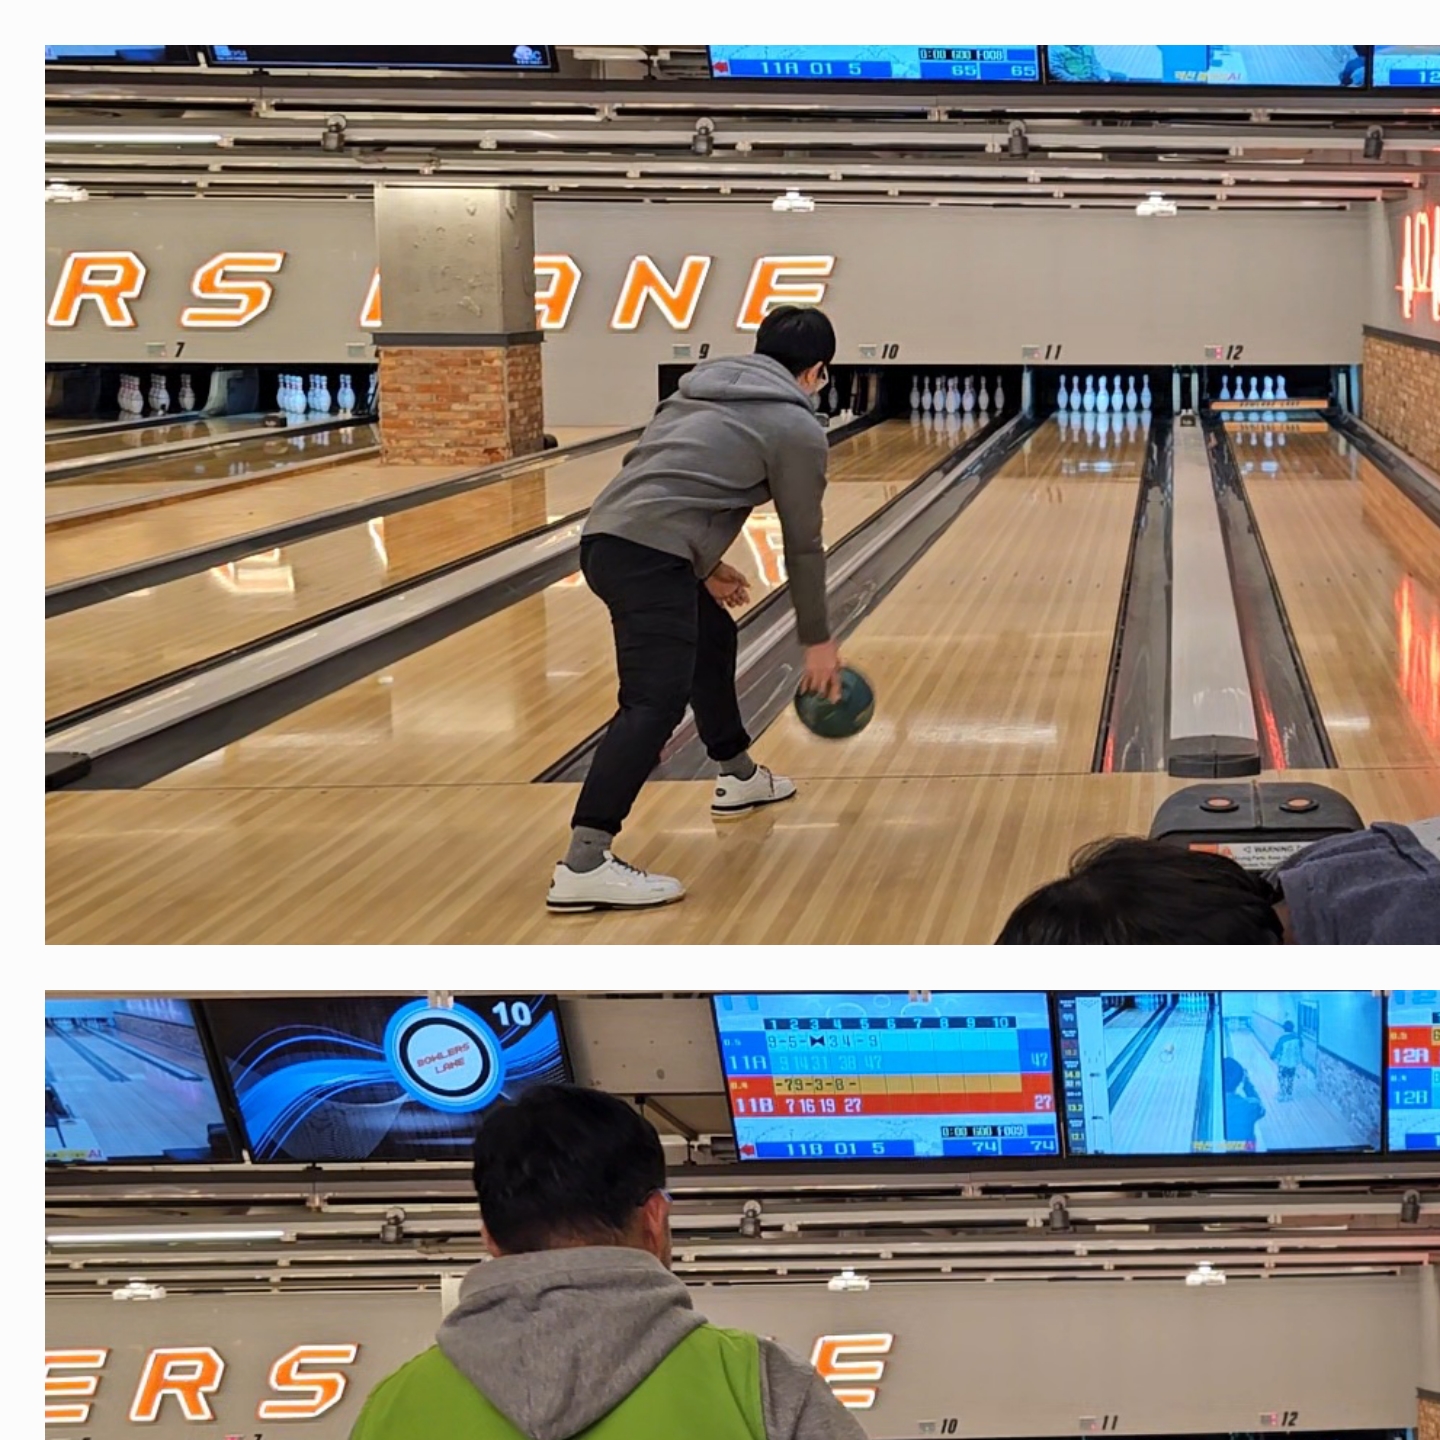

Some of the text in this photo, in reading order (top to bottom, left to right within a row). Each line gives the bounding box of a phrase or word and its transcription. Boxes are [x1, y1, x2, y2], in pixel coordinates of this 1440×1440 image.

[761, 62, 861, 74] 11A 01 5
[952, 65, 1035, 75] 65 65
[361, 255, 837, 329] ANE
[174, 342, 709, 359] 7 9
[881, 344, 1243, 360] 10 11 12
[492, 1002, 532, 1026] 10
[417, 1041, 470, 1069] BOWLERS
[730, 1056, 767, 1069] 11A
[436, 1057, 465, 1075] LANE
[800, 1099, 816, 1112] 16
[820, 1098, 835, 1112] 19
[845, 1098, 862, 1111] 27
[1034, 1095, 1051, 1109] 27
[835, 1144, 857, 1155] 01
[873, 1143, 885, 1153] 5
[973, 1140, 997, 1151] 74
[1031, 1140, 1055, 1151] 74
[940, 1411, 1298, 1434] 10 11 12
